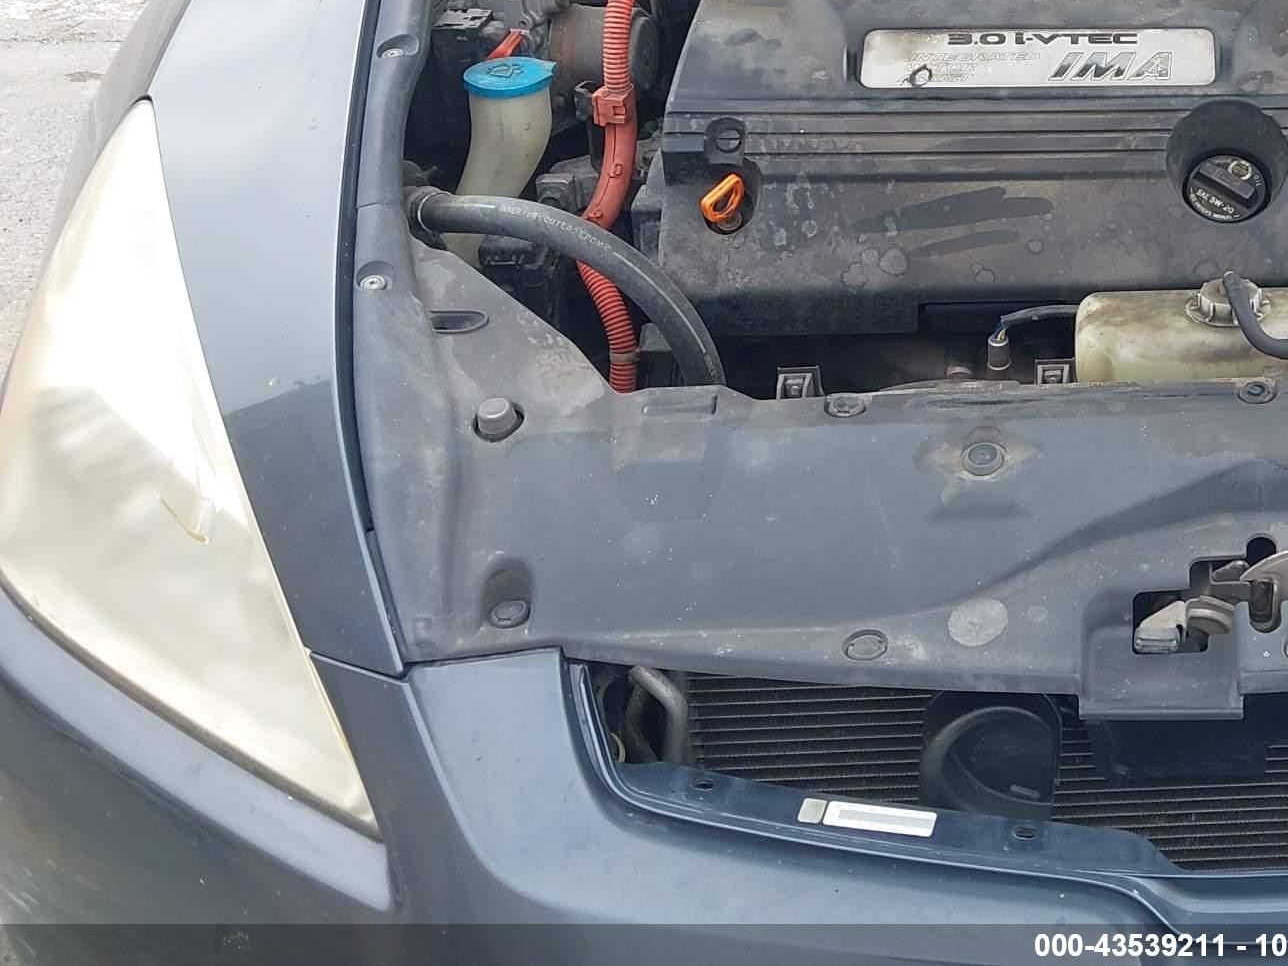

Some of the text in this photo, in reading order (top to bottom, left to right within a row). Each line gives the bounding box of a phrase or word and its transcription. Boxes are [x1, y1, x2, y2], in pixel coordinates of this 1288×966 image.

[947, 32, 1006, 45] 3.0
[909, 52, 1041, 62] INTEGRATED
[1048, 51, 1173, 82] IMA
